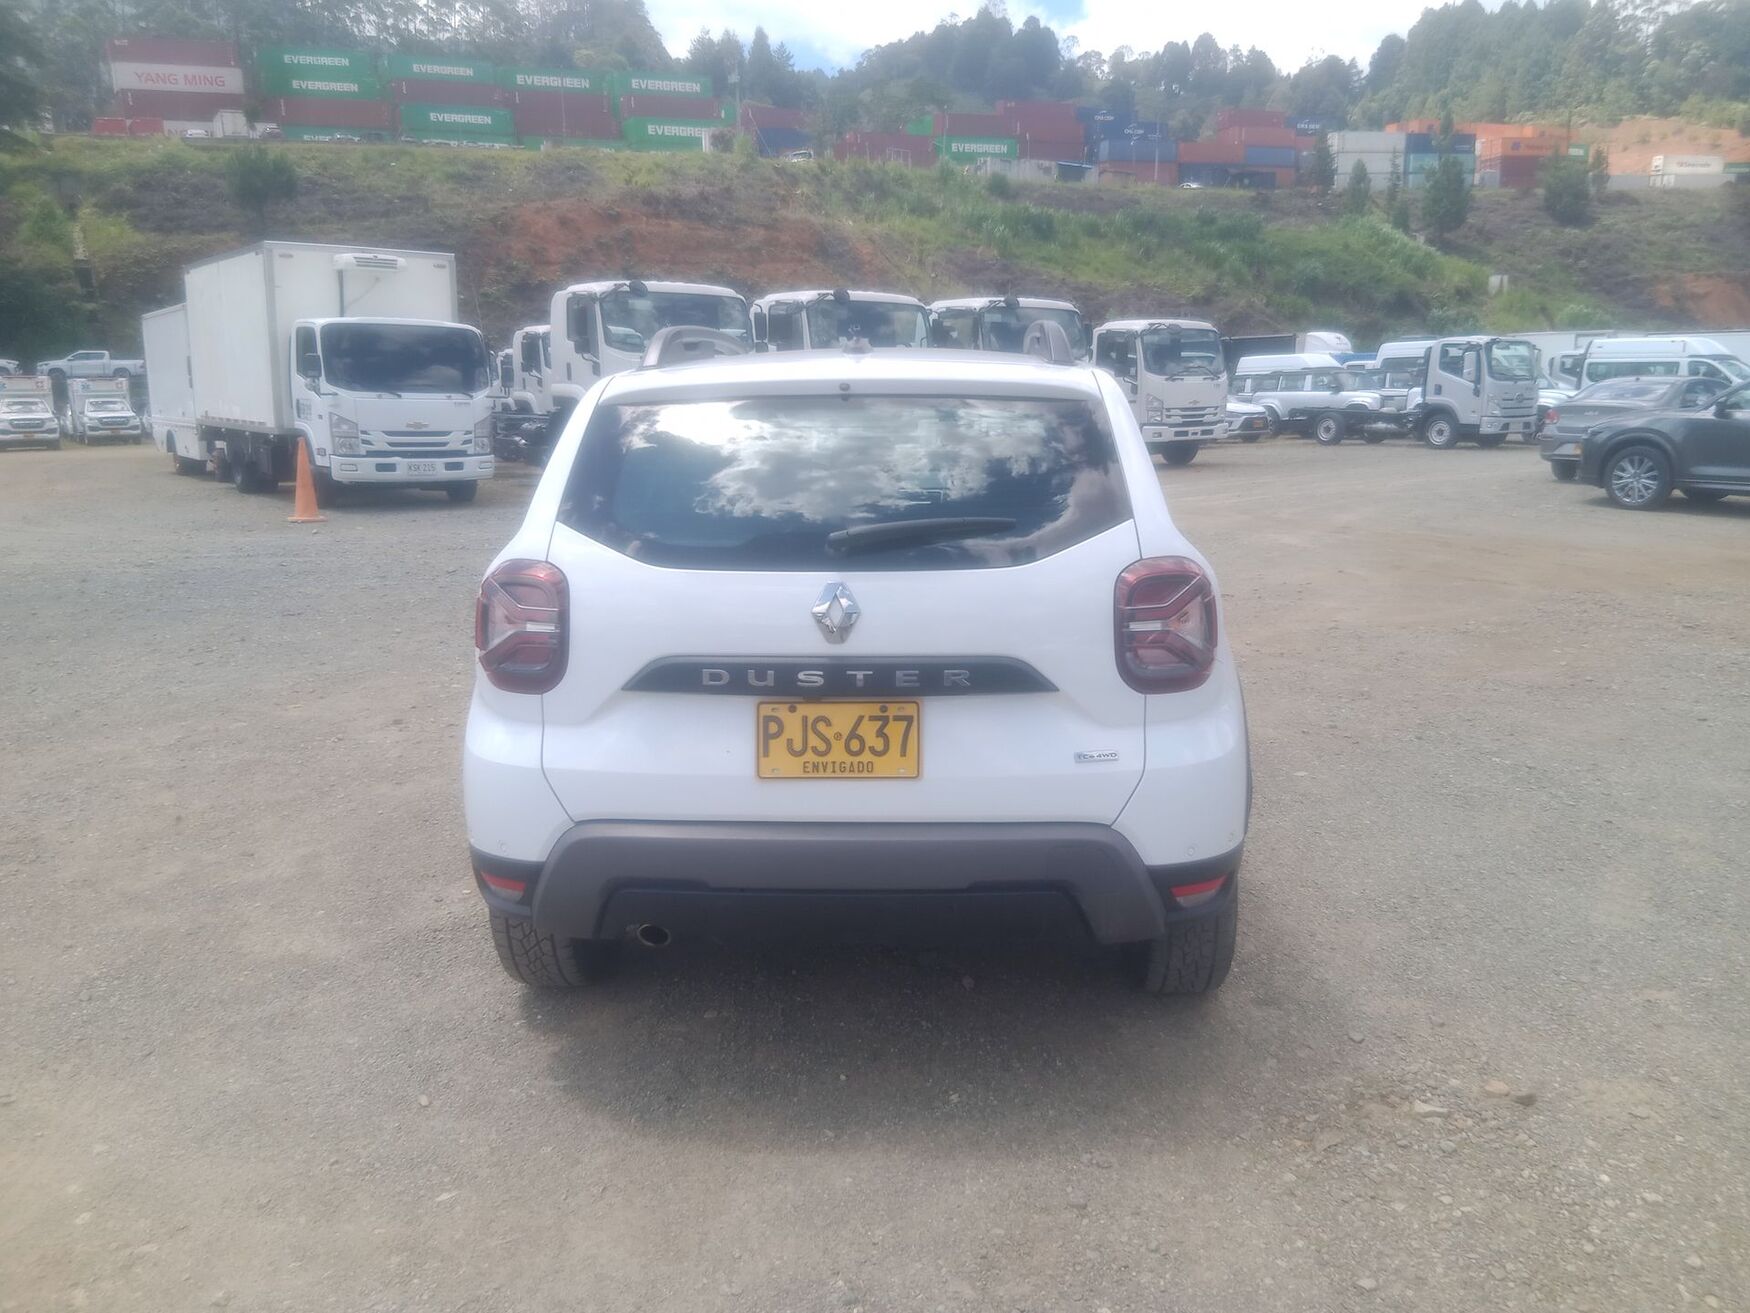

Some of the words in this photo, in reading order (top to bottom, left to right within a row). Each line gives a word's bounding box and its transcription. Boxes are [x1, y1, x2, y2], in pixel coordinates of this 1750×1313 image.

[283, 54, 350, 67] EVERGREEN
[412, 63, 474, 77] EVERGREEN
[135, 71, 178, 86] YANG
[184, 73, 225, 88] MING
[291, 79, 359, 93] EVERGREEN
[631, 78, 701, 93] EVERGREEN
[429, 111, 492, 125] EVERGREEN
[951, 142, 1008, 154] EVERGREEN
[701, 668, 972, 688] DUSTER
[802, 760, 874, 775] ENVIGADO
